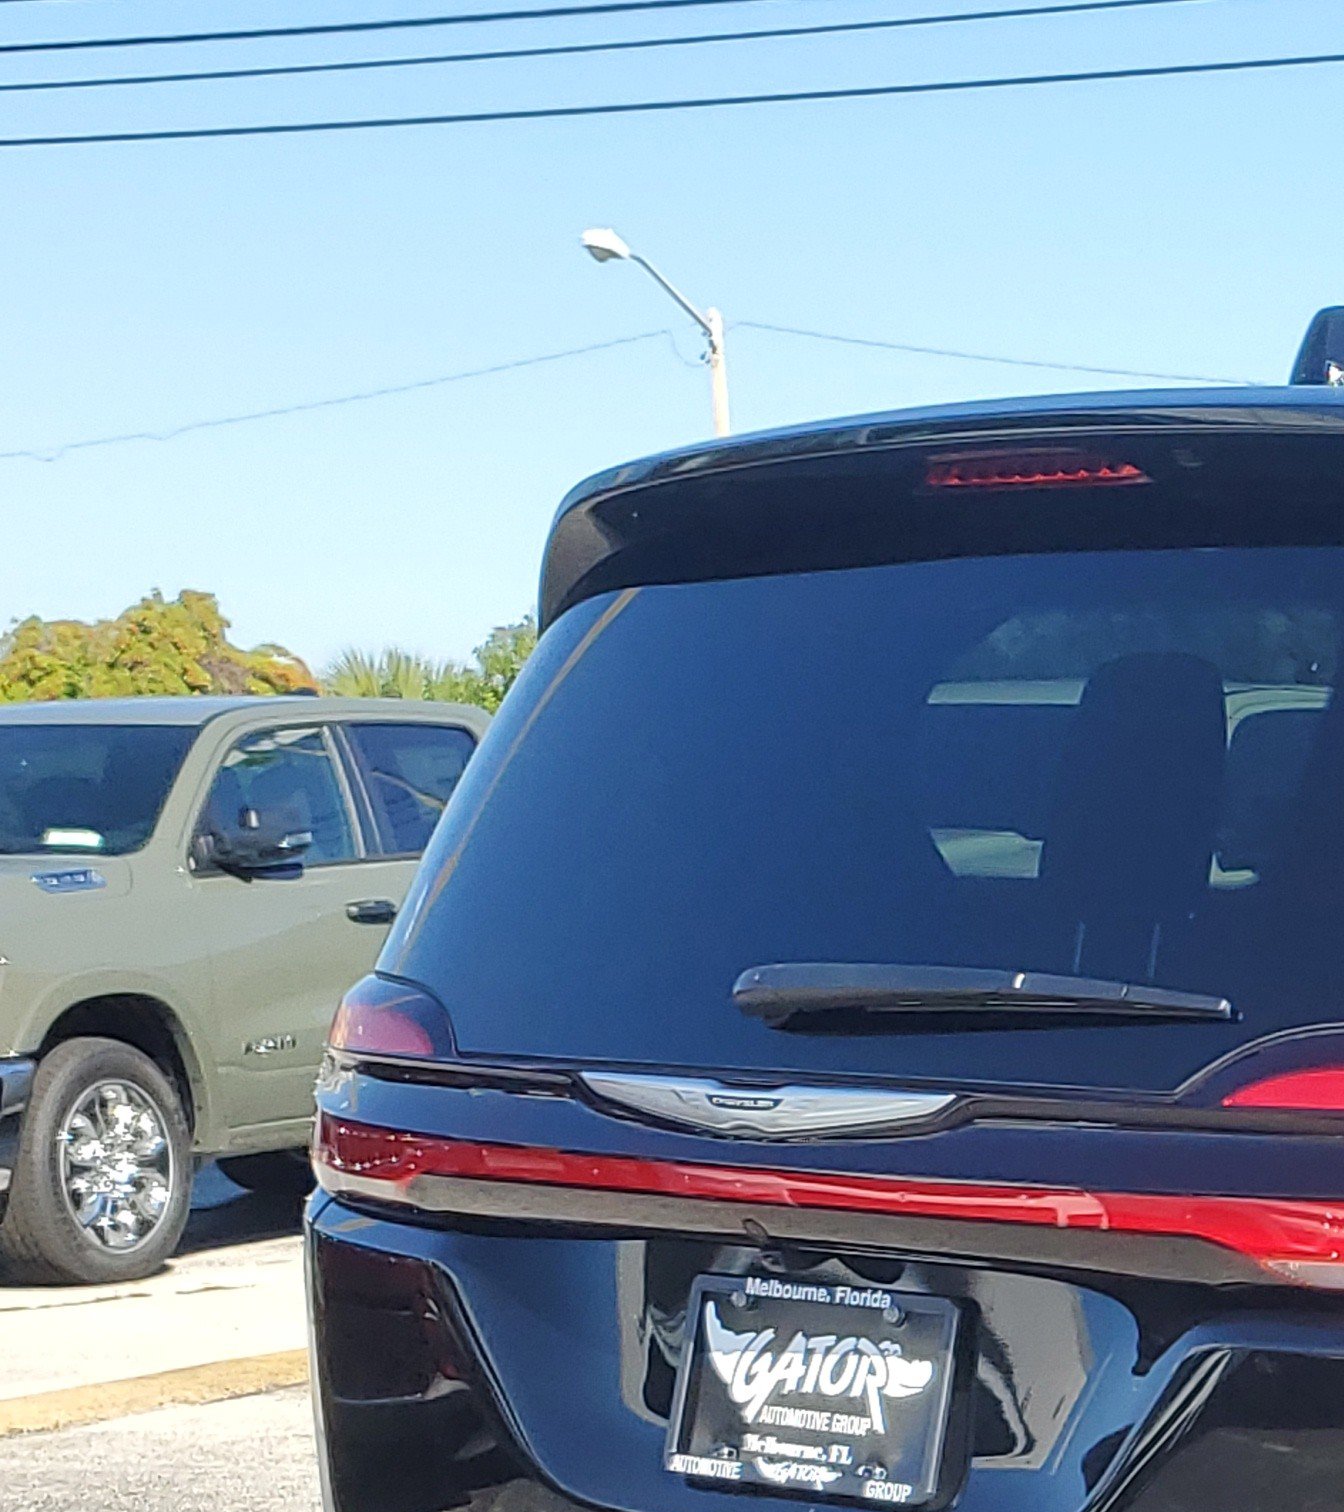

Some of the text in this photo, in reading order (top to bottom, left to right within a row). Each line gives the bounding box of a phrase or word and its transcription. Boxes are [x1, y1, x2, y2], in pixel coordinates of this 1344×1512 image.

[836, 1288, 891, 1308] Florida
[732, 1329, 886, 1434] GATOR
[760, 1406, 871, 1436] AUTOMOTIVE GROUP
[669, 1455, 742, 1479] AUTOMOTIVE
[865, 1481, 912, 1502] GROUP
